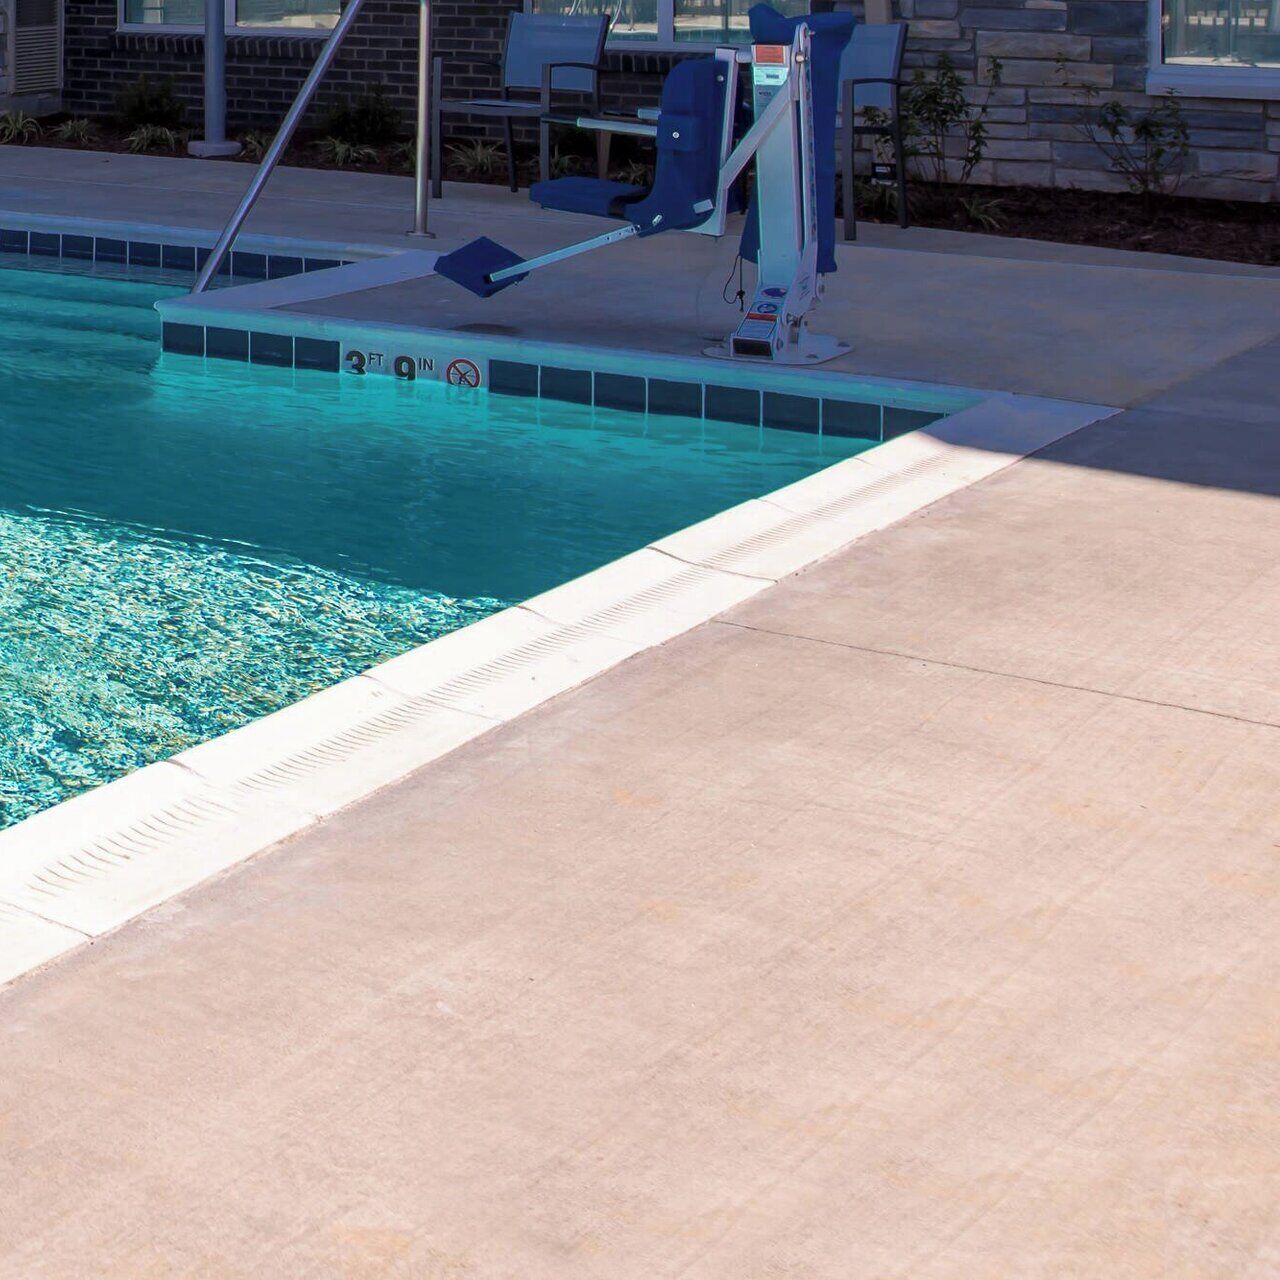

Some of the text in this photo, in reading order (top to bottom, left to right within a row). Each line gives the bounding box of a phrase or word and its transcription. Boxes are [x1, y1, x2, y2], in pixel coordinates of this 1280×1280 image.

[346, 350, 434, 381] 3 FT 9 IN
